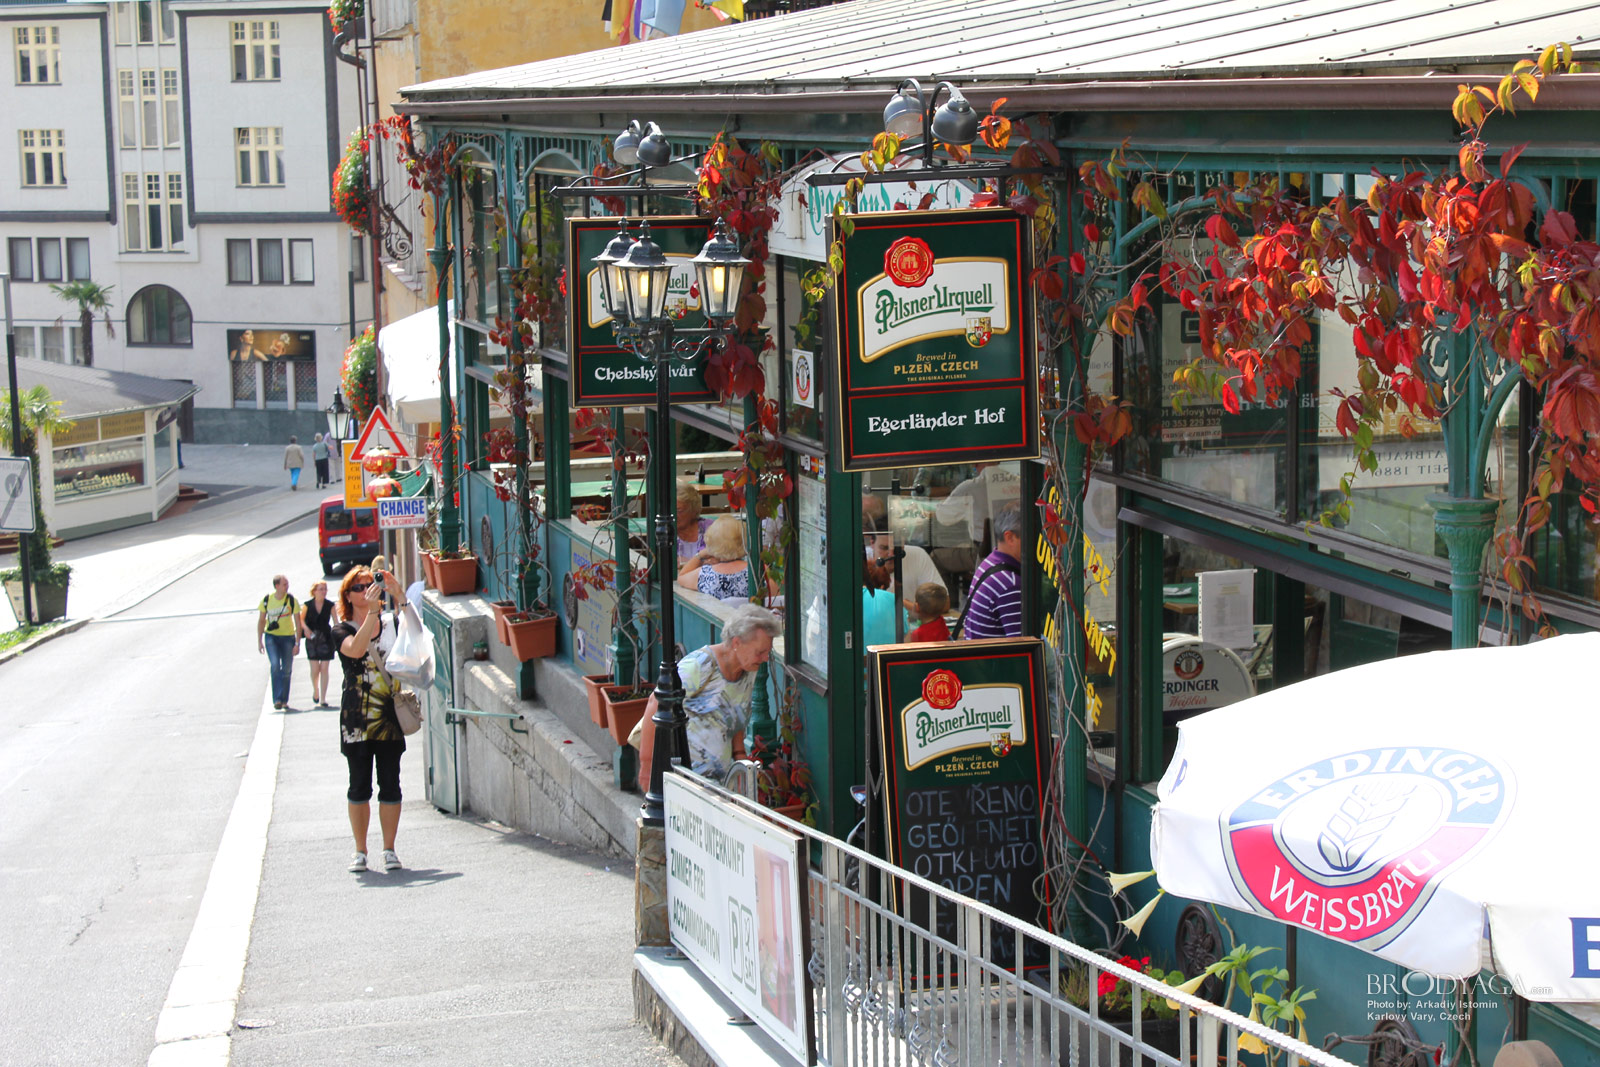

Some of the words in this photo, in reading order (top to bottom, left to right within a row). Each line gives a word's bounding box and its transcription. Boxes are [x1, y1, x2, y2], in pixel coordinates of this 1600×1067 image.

[875, 289, 936, 334] Pilsner
[933, 283, 993, 316] Urquell
[594, 365, 657, 383] Chebský
[916, 352, 946, 362] Brewed
[948, 352, 957, 360] in
[941, 360, 979, 372] CZECH
[868, 411, 968, 436] Egerländer
[974, 407, 1006, 425] Hof
[380, 500, 425, 516] CHANGE
[915, 711, 965, 748] Pilsner
[962, 705, 1011, 732] Urquell
[970, 761, 999, 770] CZECH
[1253, 749, 1500, 813] ERDINGER
[704, 821, 745, 877] UNTERKUNFT
[670, 847, 693, 887] ZIMMER
[693, 865, 706, 900] FREI
[1269, 849, 1441, 933] WEISSBRÄU
[673, 895, 721, 964] ACCOMMODATION
[745, 956, 755, 983] SAT
